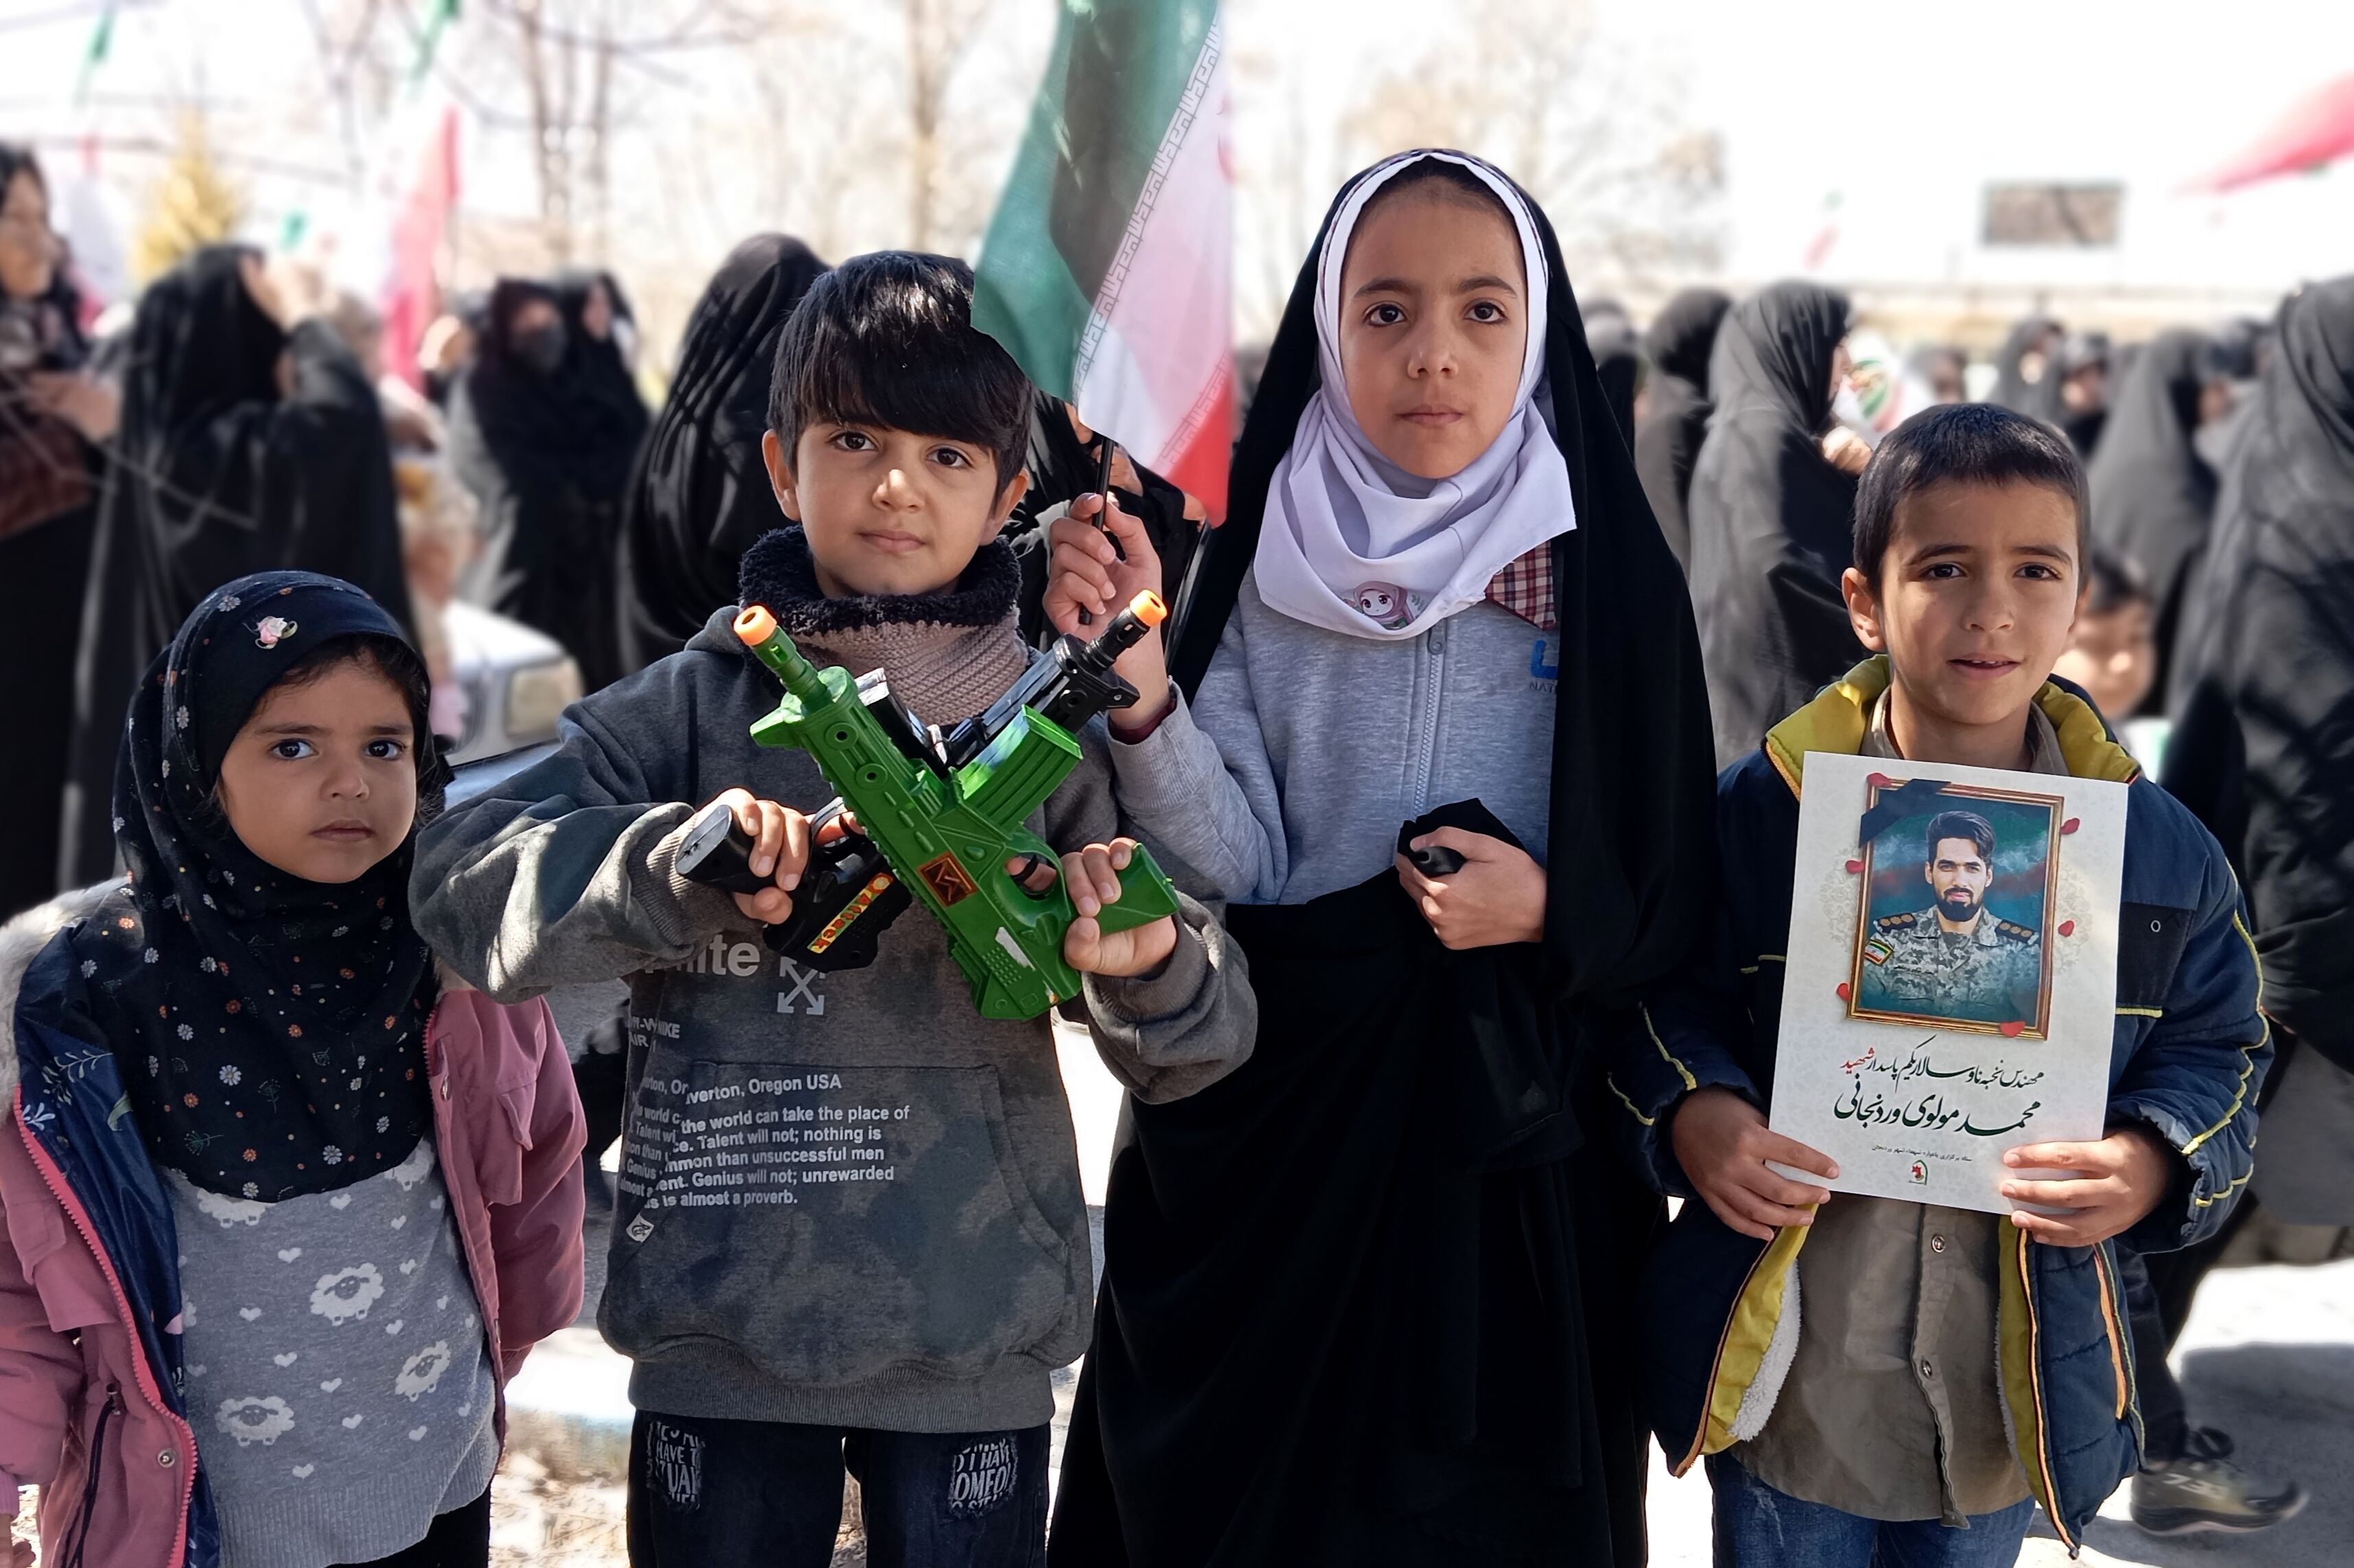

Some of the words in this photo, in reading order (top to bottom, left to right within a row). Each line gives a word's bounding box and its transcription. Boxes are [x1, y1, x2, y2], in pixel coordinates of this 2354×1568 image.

[1529, 681, 1557, 694] NAT
[813, 892, 872, 948] Attack
[1840, 1047, 1875, 1075] شهید
[1865, 1056, 1898, 1080] پاسدار
[749, 1079, 802, 1095] Oregon
[807, 1074, 842, 1090] USA
[2000, 1069, 2044, 1088] مهندس
[681, 1119, 706, 1134] the
[709, 1110, 752, 1129] world
[755, 1110, 779, 1123] can
[782, 1106, 814, 1122] take
[818, 1106, 843, 1120] the
[848, 1105, 889, 1123] place
[894, 1105, 910, 1120] of
[1902, 1094, 1959, 1129] مولوی
[1953, 1101, 2041, 1136] محمد
[696, 1131, 744, 1149] Talent
[747, 1129, 768, 1144] will
[772, 1127, 799, 1144] not;
[803, 1127, 863, 1143] nothing
[868, 1125, 882, 1140] is
[716, 1152, 749, 1166] than
[753, 1147, 847, 1164] unsuccessful
[851, 1149, 884, 1160] men
[655, 1175, 688, 1191] ent.
[692, 1171, 744, 1187] Genius
[747, 1168, 766, 1184] will
[770, 1169, 797, 1186] not;
[802, 1165, 894, 1183] unrewarded
[662, 1195, 677, 1206] is
[680, 1191, 729, 1206] almost
[733, 1192, 740, 1204] a
[744, 1189, 798, 1208] proverb.
